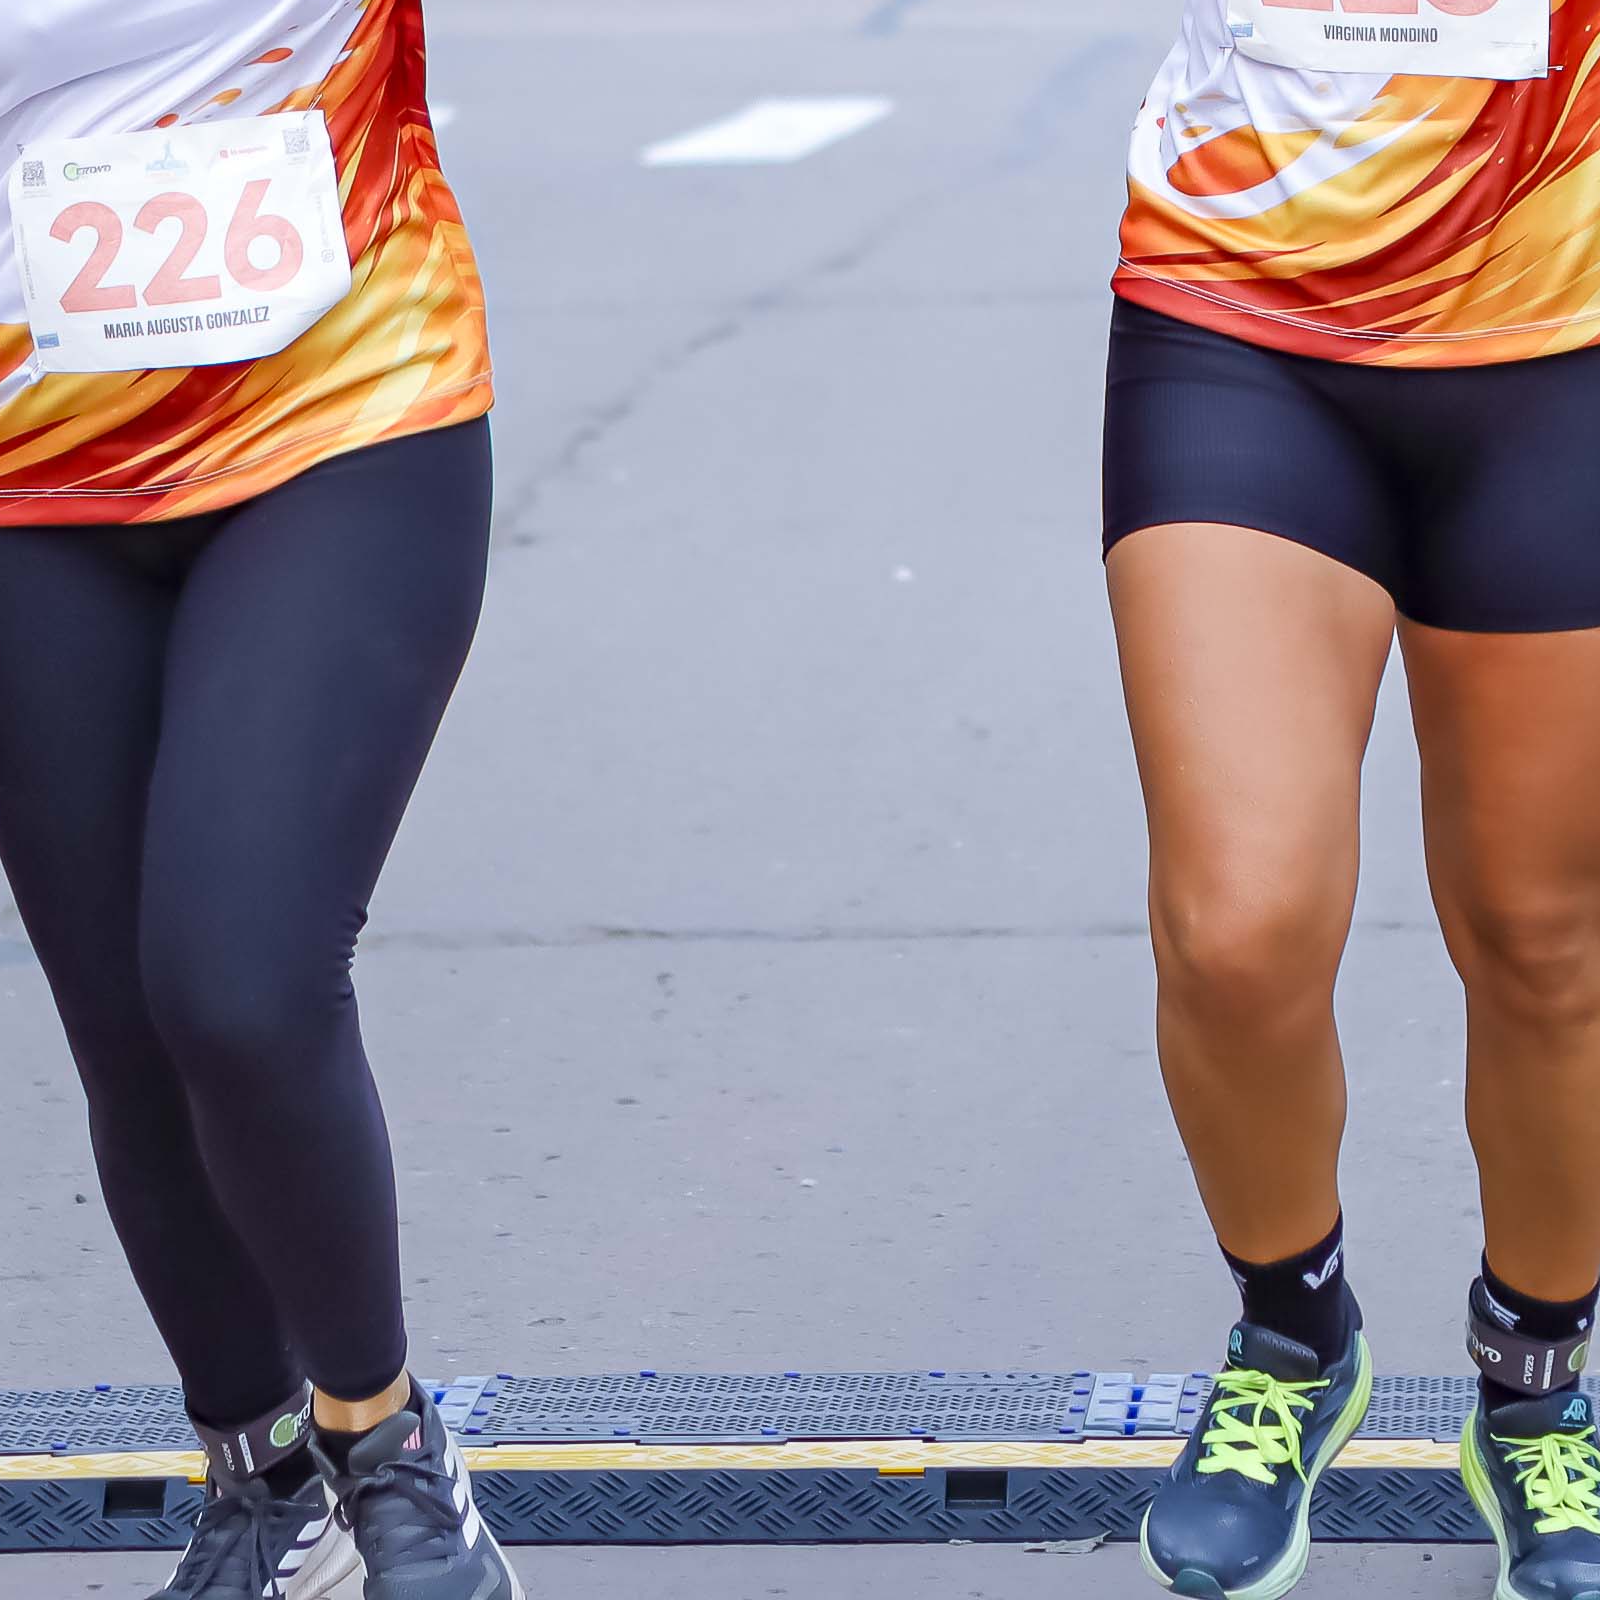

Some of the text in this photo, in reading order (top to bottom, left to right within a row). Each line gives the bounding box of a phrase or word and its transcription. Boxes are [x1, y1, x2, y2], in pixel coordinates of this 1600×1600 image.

[1323, 24, 1439, 43] VIRGINIA MONDINO
[48, 178, 304, 313] 226
[103, 305, 271, 340] MARIA AUGUSTA GONZALEZ
